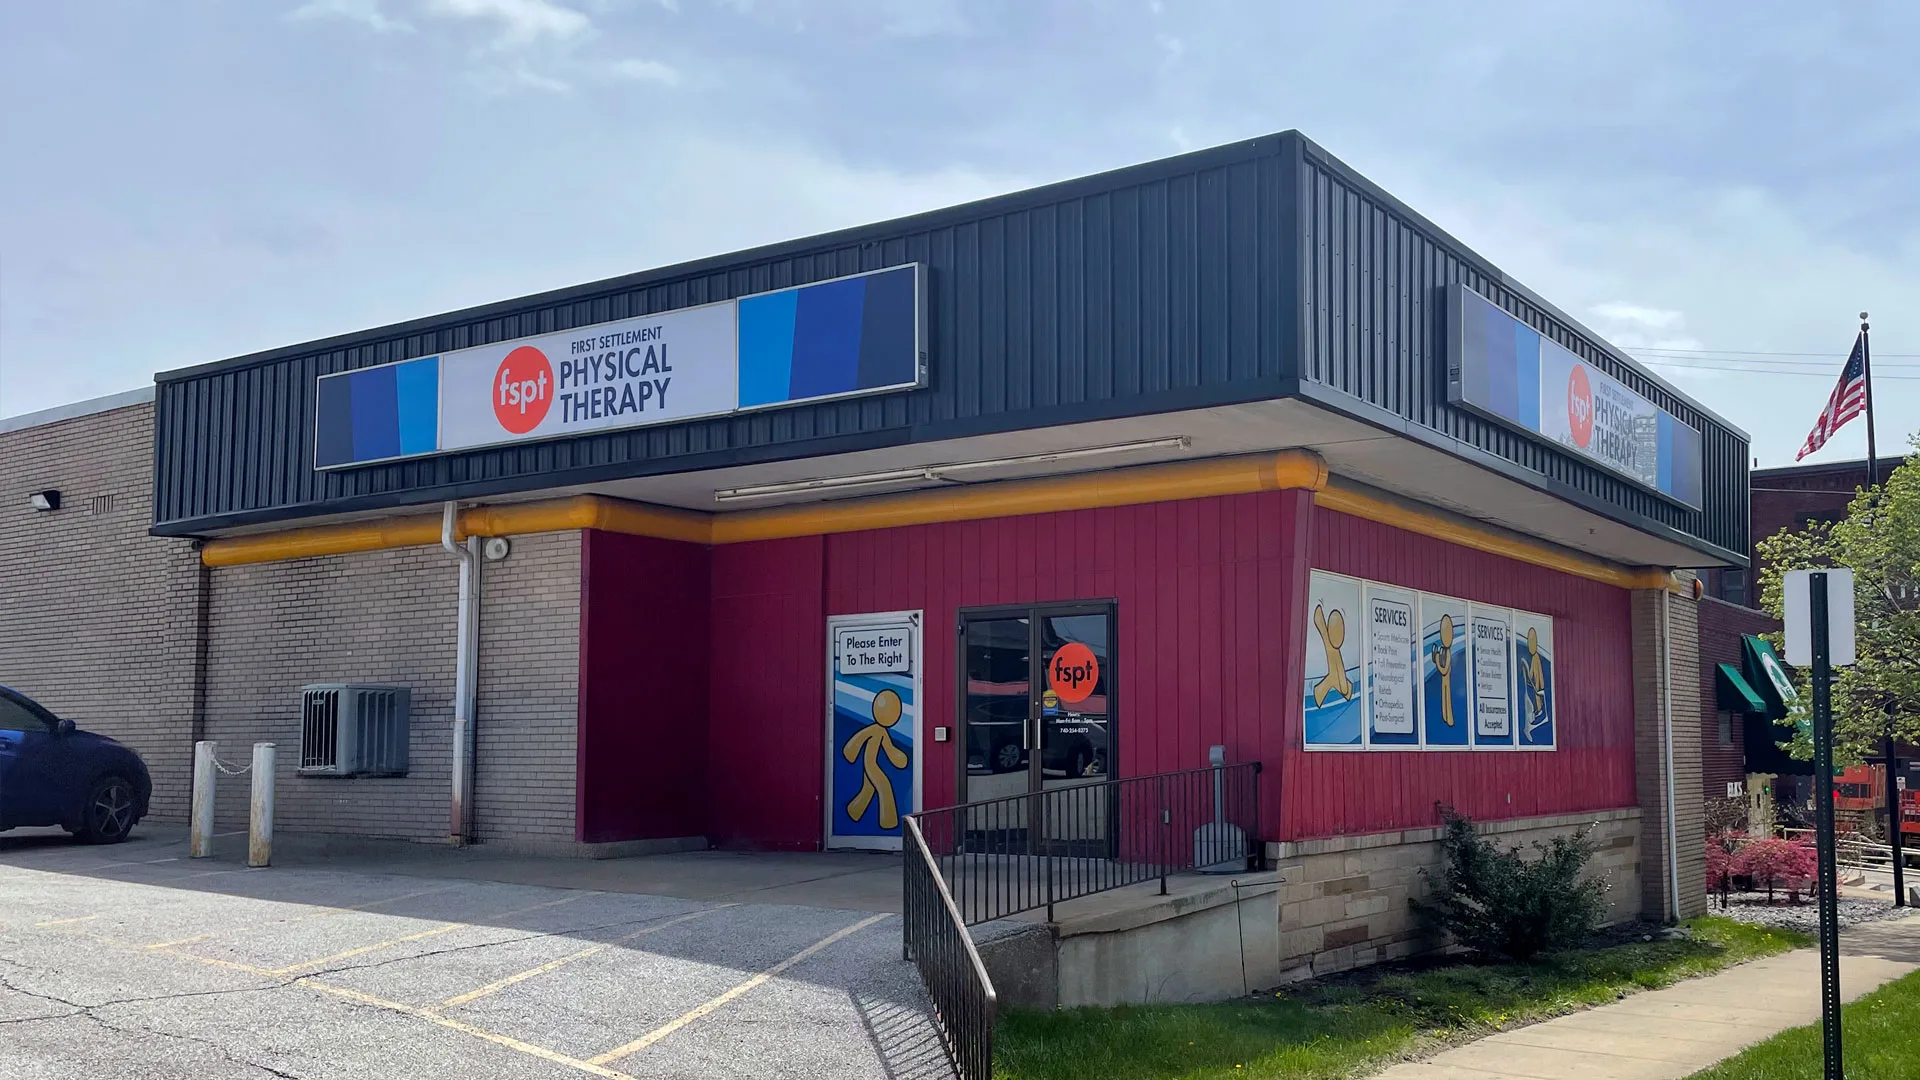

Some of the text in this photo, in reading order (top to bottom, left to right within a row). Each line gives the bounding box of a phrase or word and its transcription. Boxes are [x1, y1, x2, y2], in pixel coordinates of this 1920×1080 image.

[571, 326, 663, 354] FIRST SETTLEMENT
[560, 343, 672, 389] PHYSICAL
[500, 368, 547, 414] fspt
[560, 377, 671, 423] THERAPY
[1571, 380, 1590, 429] fspt
[1594, 395, 1637, 441] PHYSICAL
[1595, 425, 1637, 470] THERAPY
[1375, 606, 1407, 627] SERVICES
[1477, 624, 1503, 642] SERVICES
[846, 635, 902, 649] Please Enter
[846, 651, 902, 667] To The Right
[1055, 656, 1092, 689] fspt
[1484, 717, 1503, 732] Accepted
